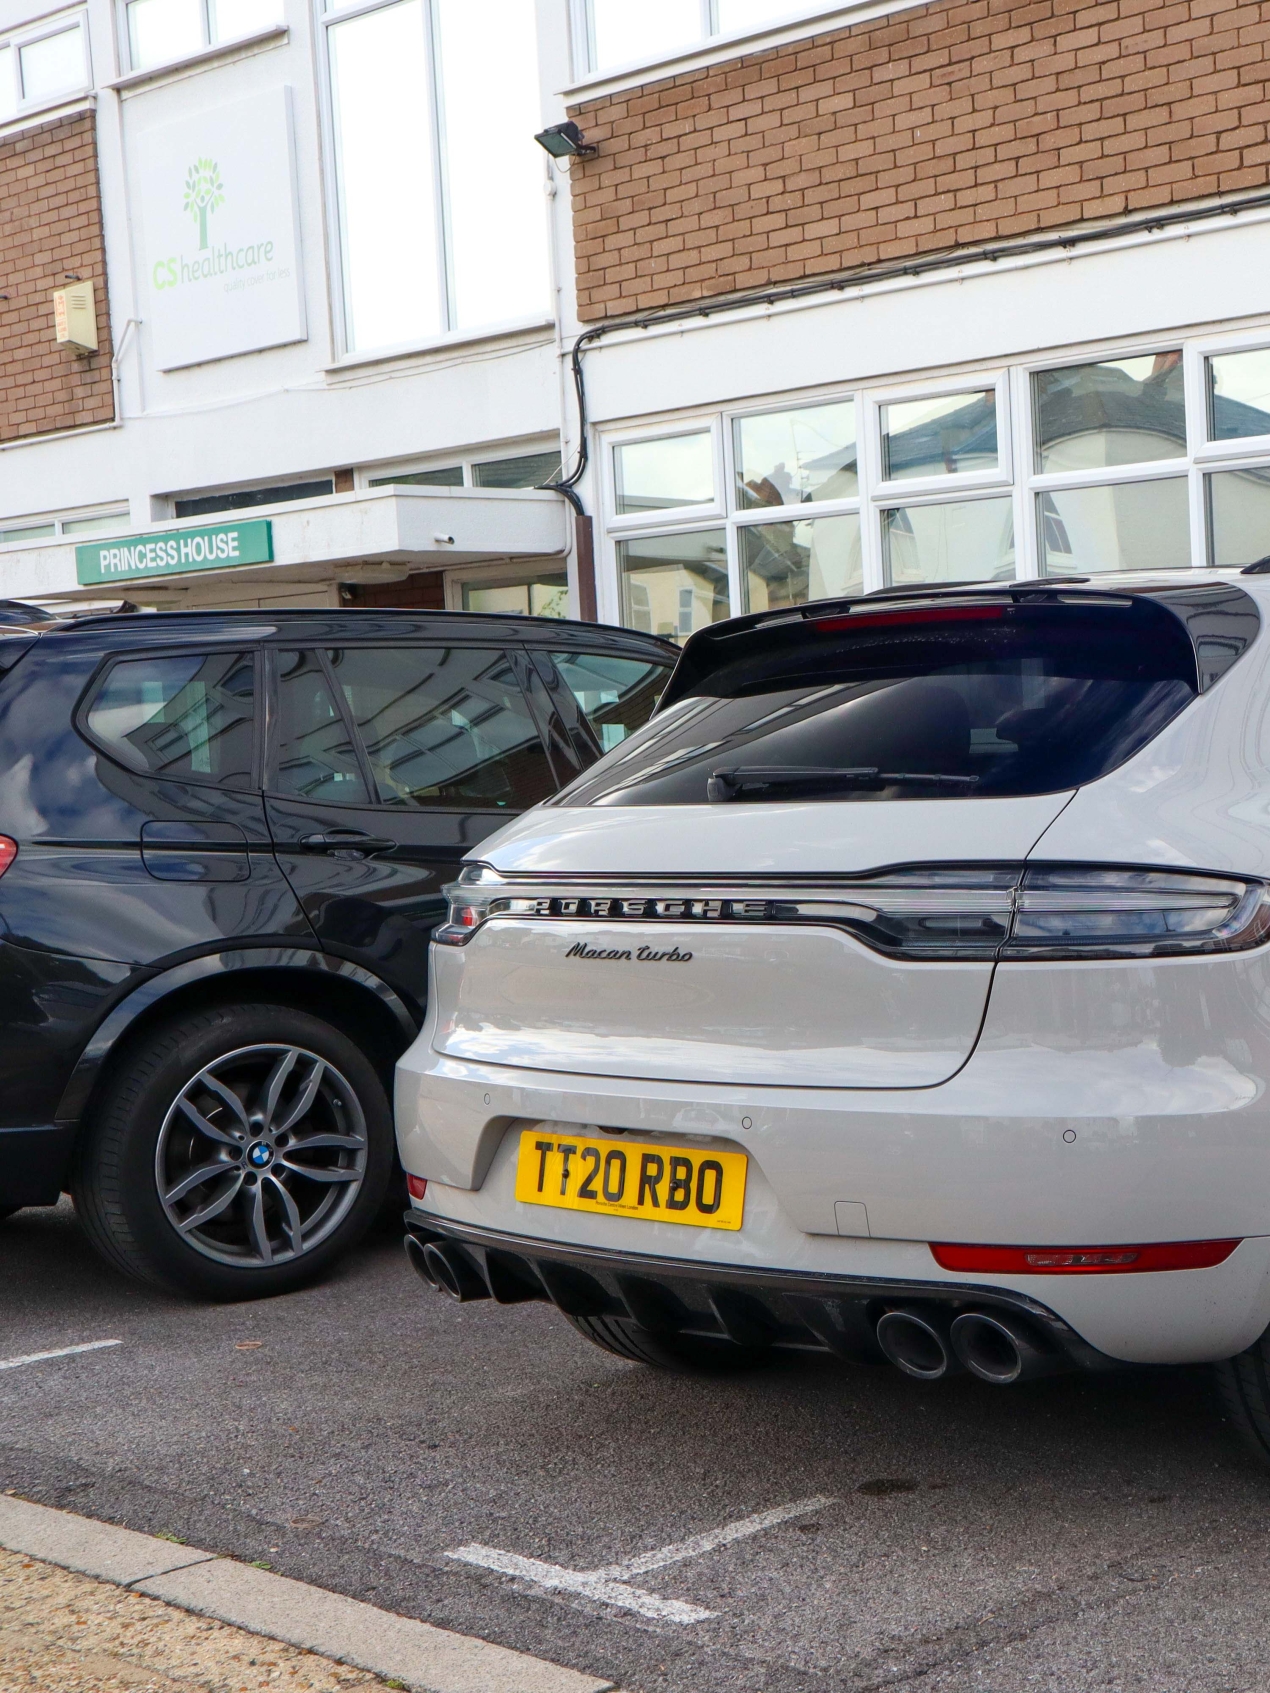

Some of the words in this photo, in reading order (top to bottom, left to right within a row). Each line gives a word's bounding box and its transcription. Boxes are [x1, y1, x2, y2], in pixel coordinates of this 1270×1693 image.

[153, 257, 178, 290] CS
[180, 240, 274, 284] healthcare
[100, 540, 178, 573] PRINCESS
[180, 532, 240, 563] HOUSE
[533, 899, 769, 918] PORSCHE
[565, 941, 632, 961] Macan
[535, 1141, 627, 1202] TT20
[637, 1153, 724, 1214] RBO
